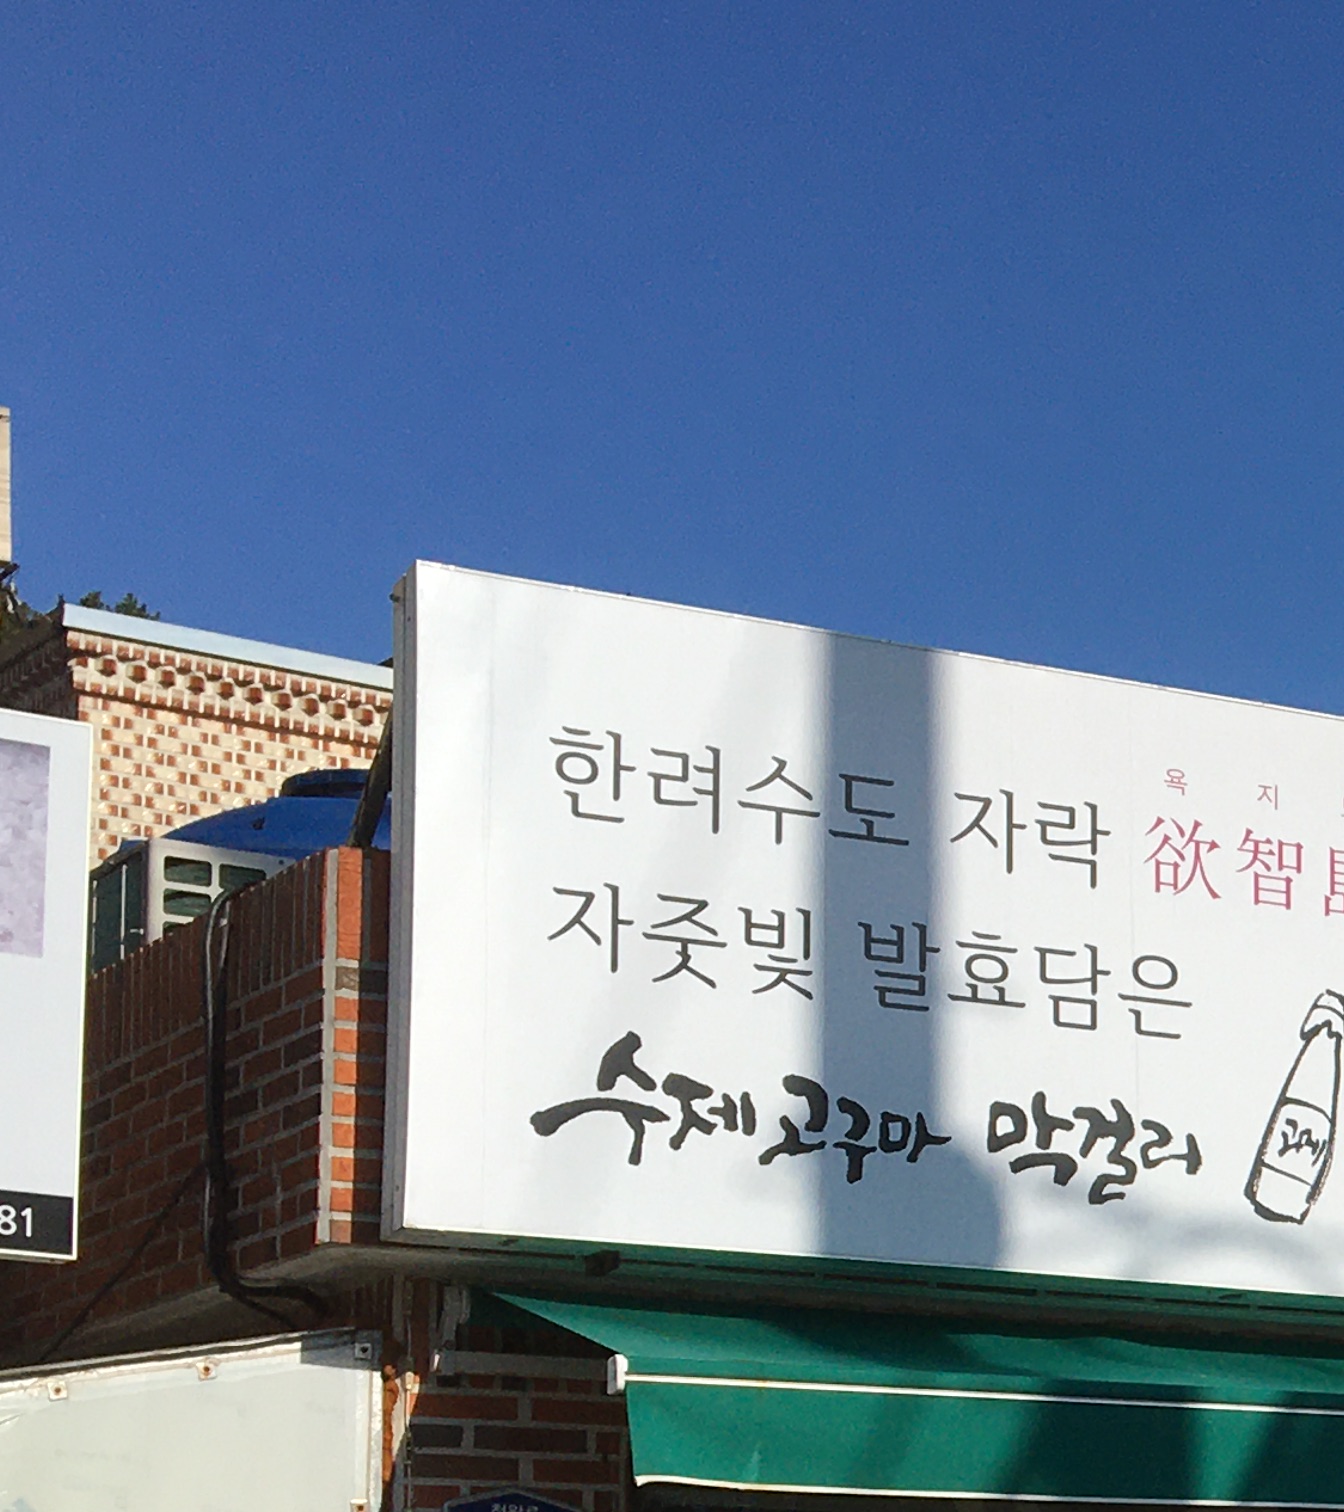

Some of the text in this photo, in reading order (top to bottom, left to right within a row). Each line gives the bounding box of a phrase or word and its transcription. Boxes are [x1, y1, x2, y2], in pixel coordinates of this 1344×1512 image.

[549, 725, 910, 846] 한려수도
[949, 788, 1112, 889] 자락
[547, 882, 1193, 1041] 자줏빛 발효담은
[531, 1030, 1203, 1205] 수제 고구마 막걸리
